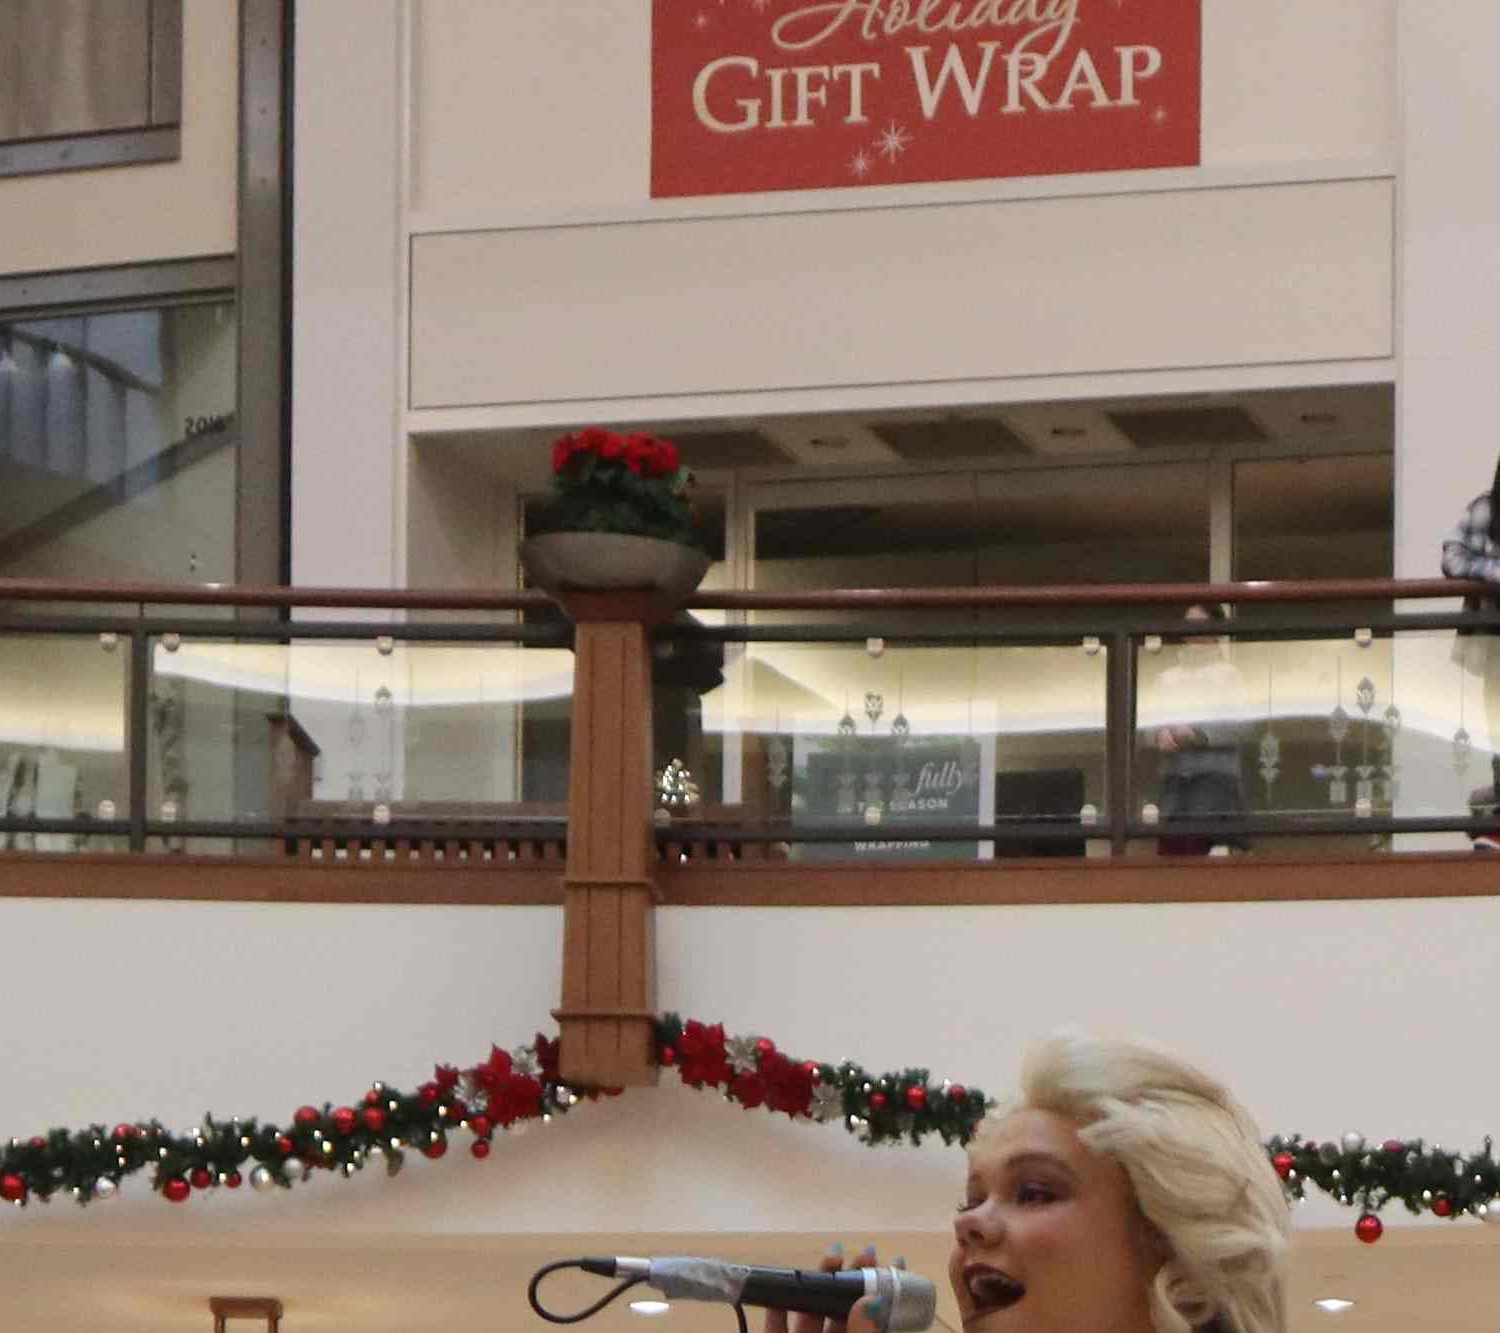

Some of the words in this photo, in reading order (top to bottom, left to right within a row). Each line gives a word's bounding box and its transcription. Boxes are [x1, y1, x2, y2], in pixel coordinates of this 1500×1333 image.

[772, 0, 1080, 63] Holiday
[692, 56, 880, 133] GIFT
[904, 40, 1163, 120] WRAP
